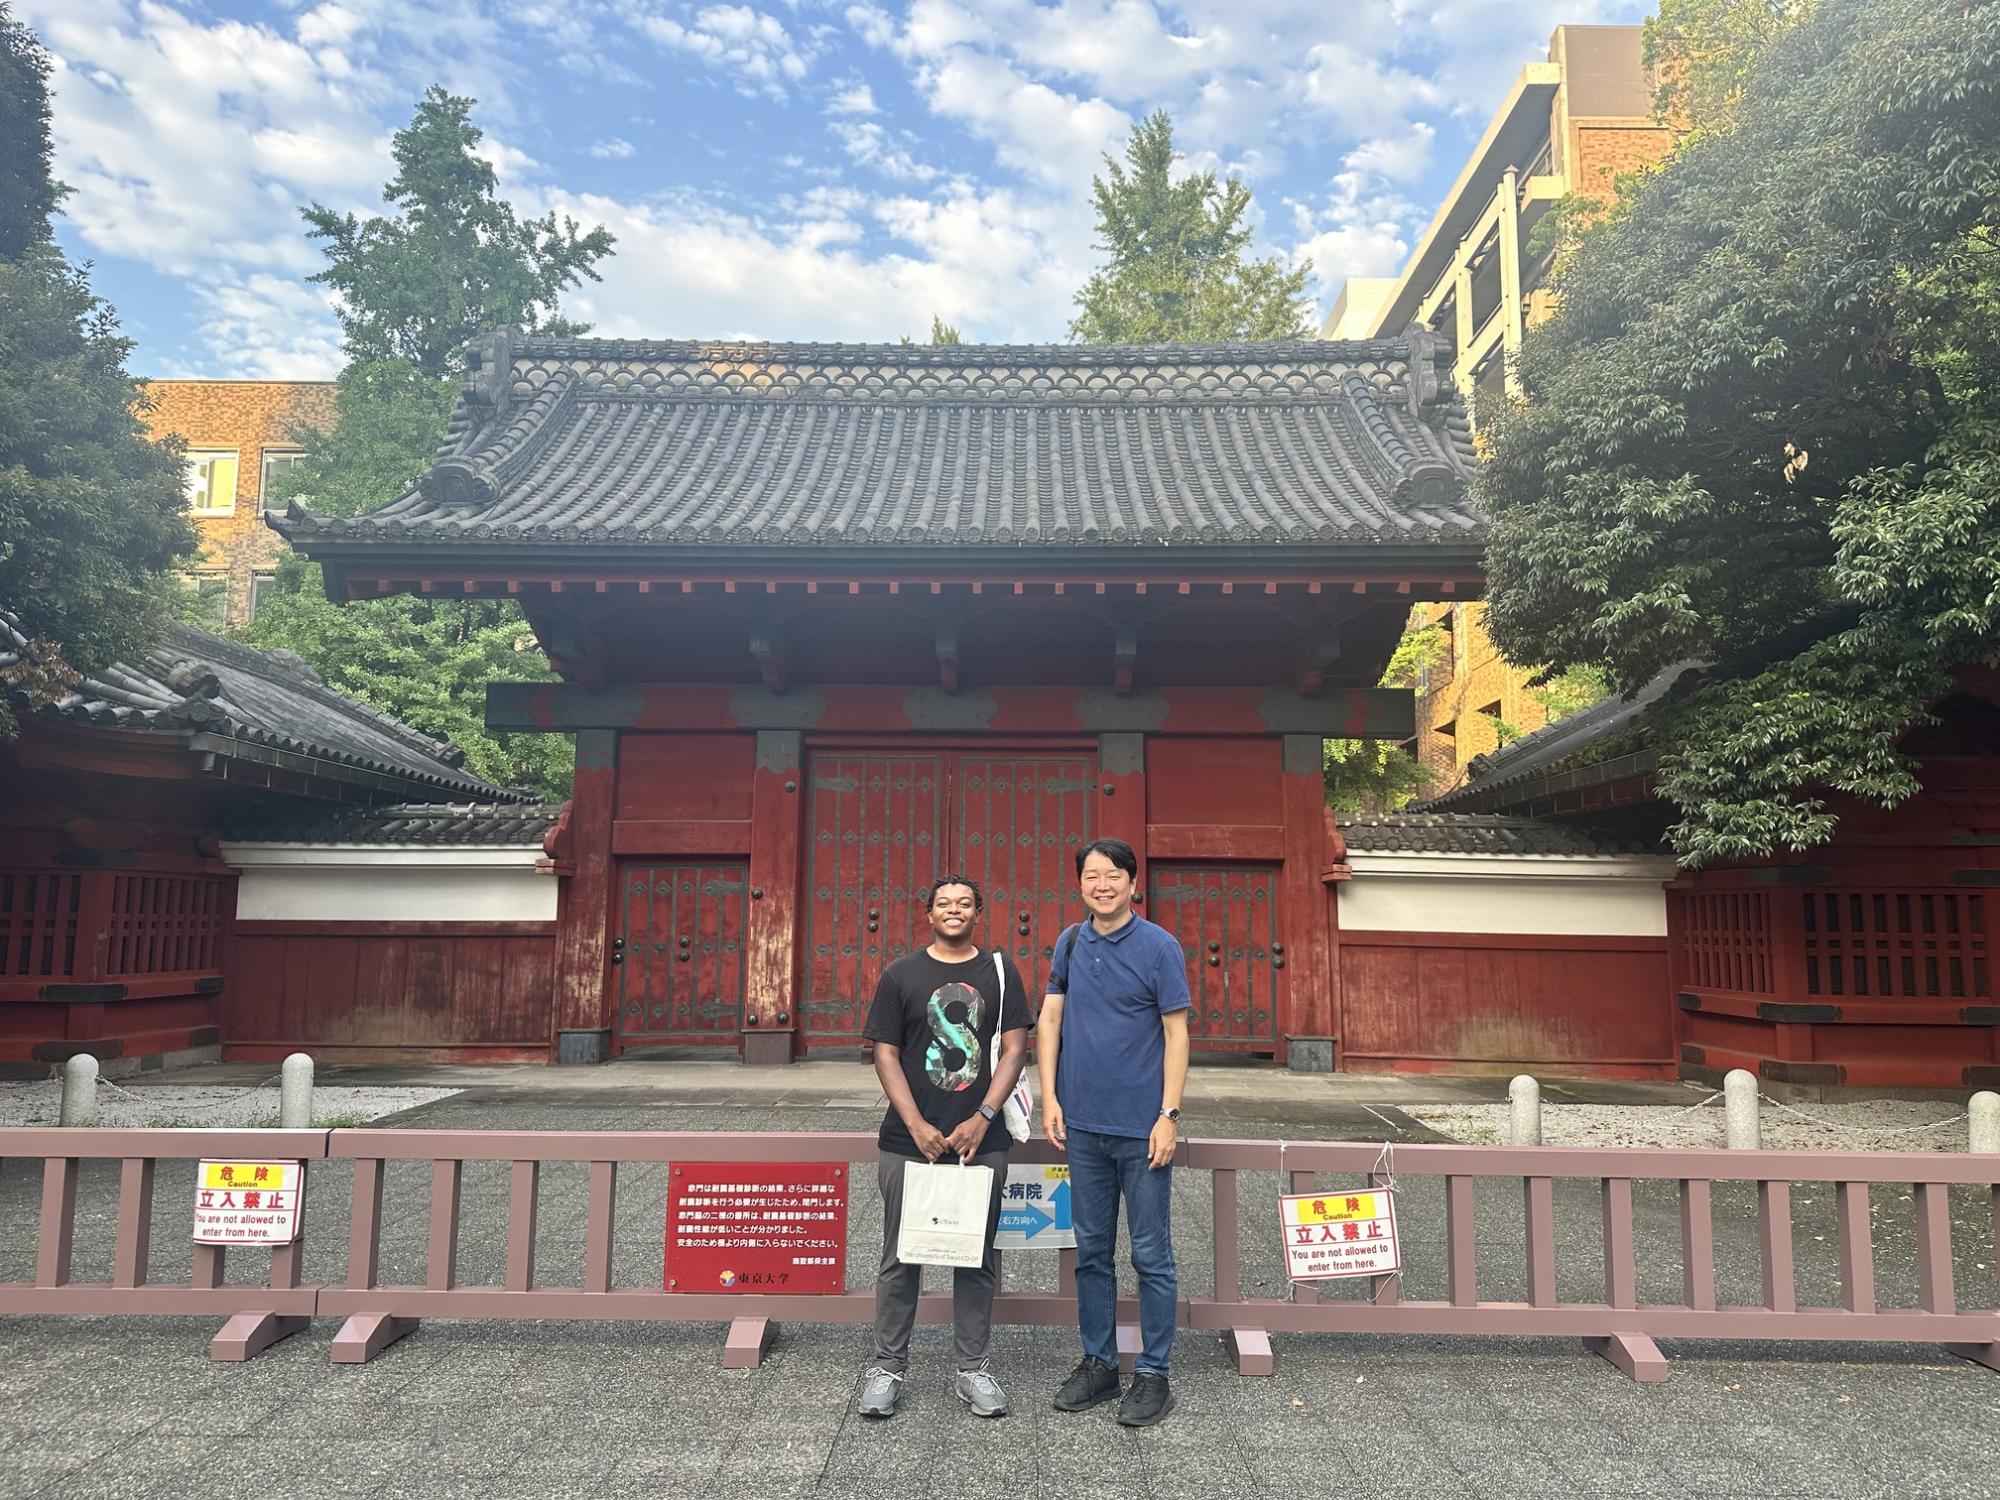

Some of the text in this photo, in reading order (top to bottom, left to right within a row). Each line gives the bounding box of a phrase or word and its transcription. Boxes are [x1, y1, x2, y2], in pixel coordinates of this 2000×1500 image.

[219, 1166, 269, 1181] 危険
[200, 1191, 284, 1209] 立入禁止
[1312, 1197, 1360, 1215] 危険
[207, 1216, 220, 1224] are
[223, 1215, 238, 1224] not
[240, 1214, 273, 1224] allowed
[277, 1215, 287, 1224] to
[1323, 1213, 1352, 1221] Caution
[202, 1228, 270, 1238] enter from here.
[1295, 1221, 1383, 1244] 立入禁止
[1291, 1244, 1388, 1260] You are not allowed to
[1308, 1259, 1377, 1273] enter from here.
[738, 1272, 790, 1285] 東京大学
